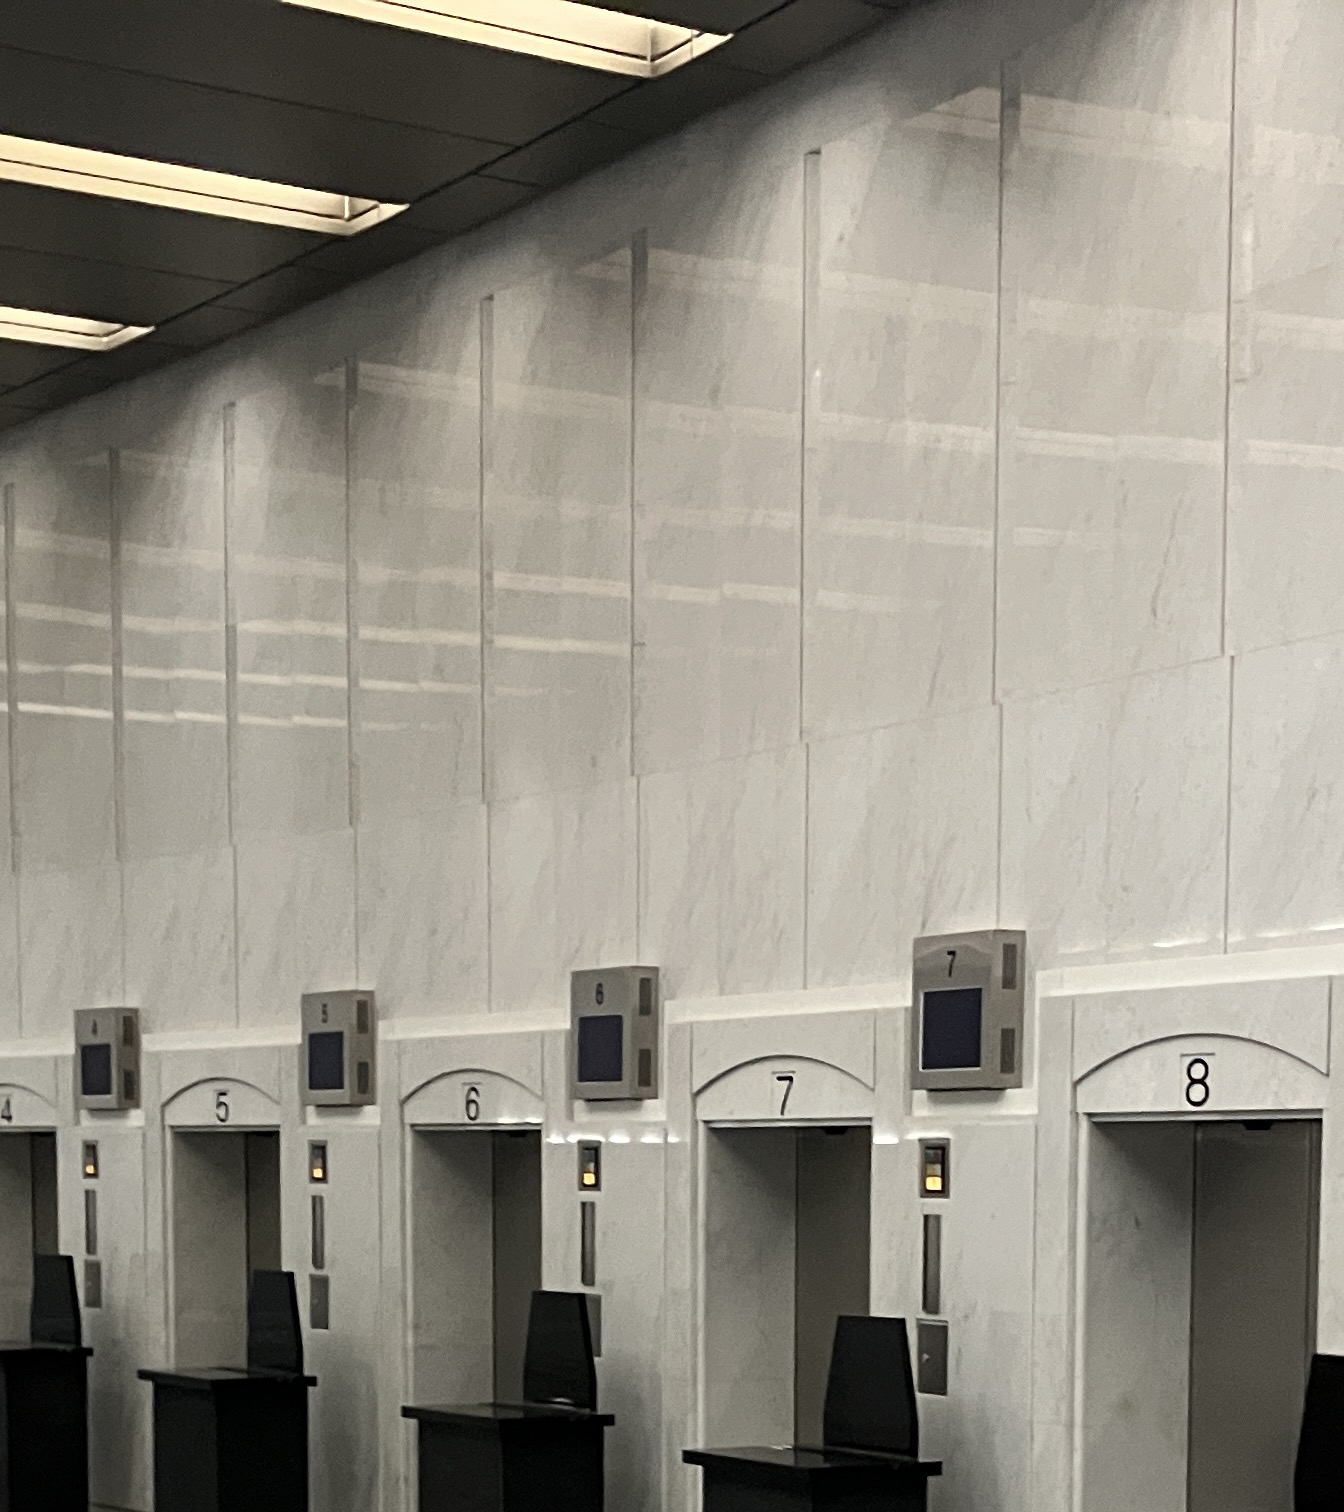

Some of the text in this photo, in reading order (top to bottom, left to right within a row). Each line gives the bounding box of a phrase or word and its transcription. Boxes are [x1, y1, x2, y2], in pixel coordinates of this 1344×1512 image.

[947, 950, 956, 978] 7
[595, 982, 604, 1005] 6
[776, 1075, 794, 1116] 7
[1185, 1058, 1209, 1107] 8
[0, 1097, 12, 1123] 4
[215, 1092, 229, 1123] 5
[465, 1086, 480, 1121] 6
